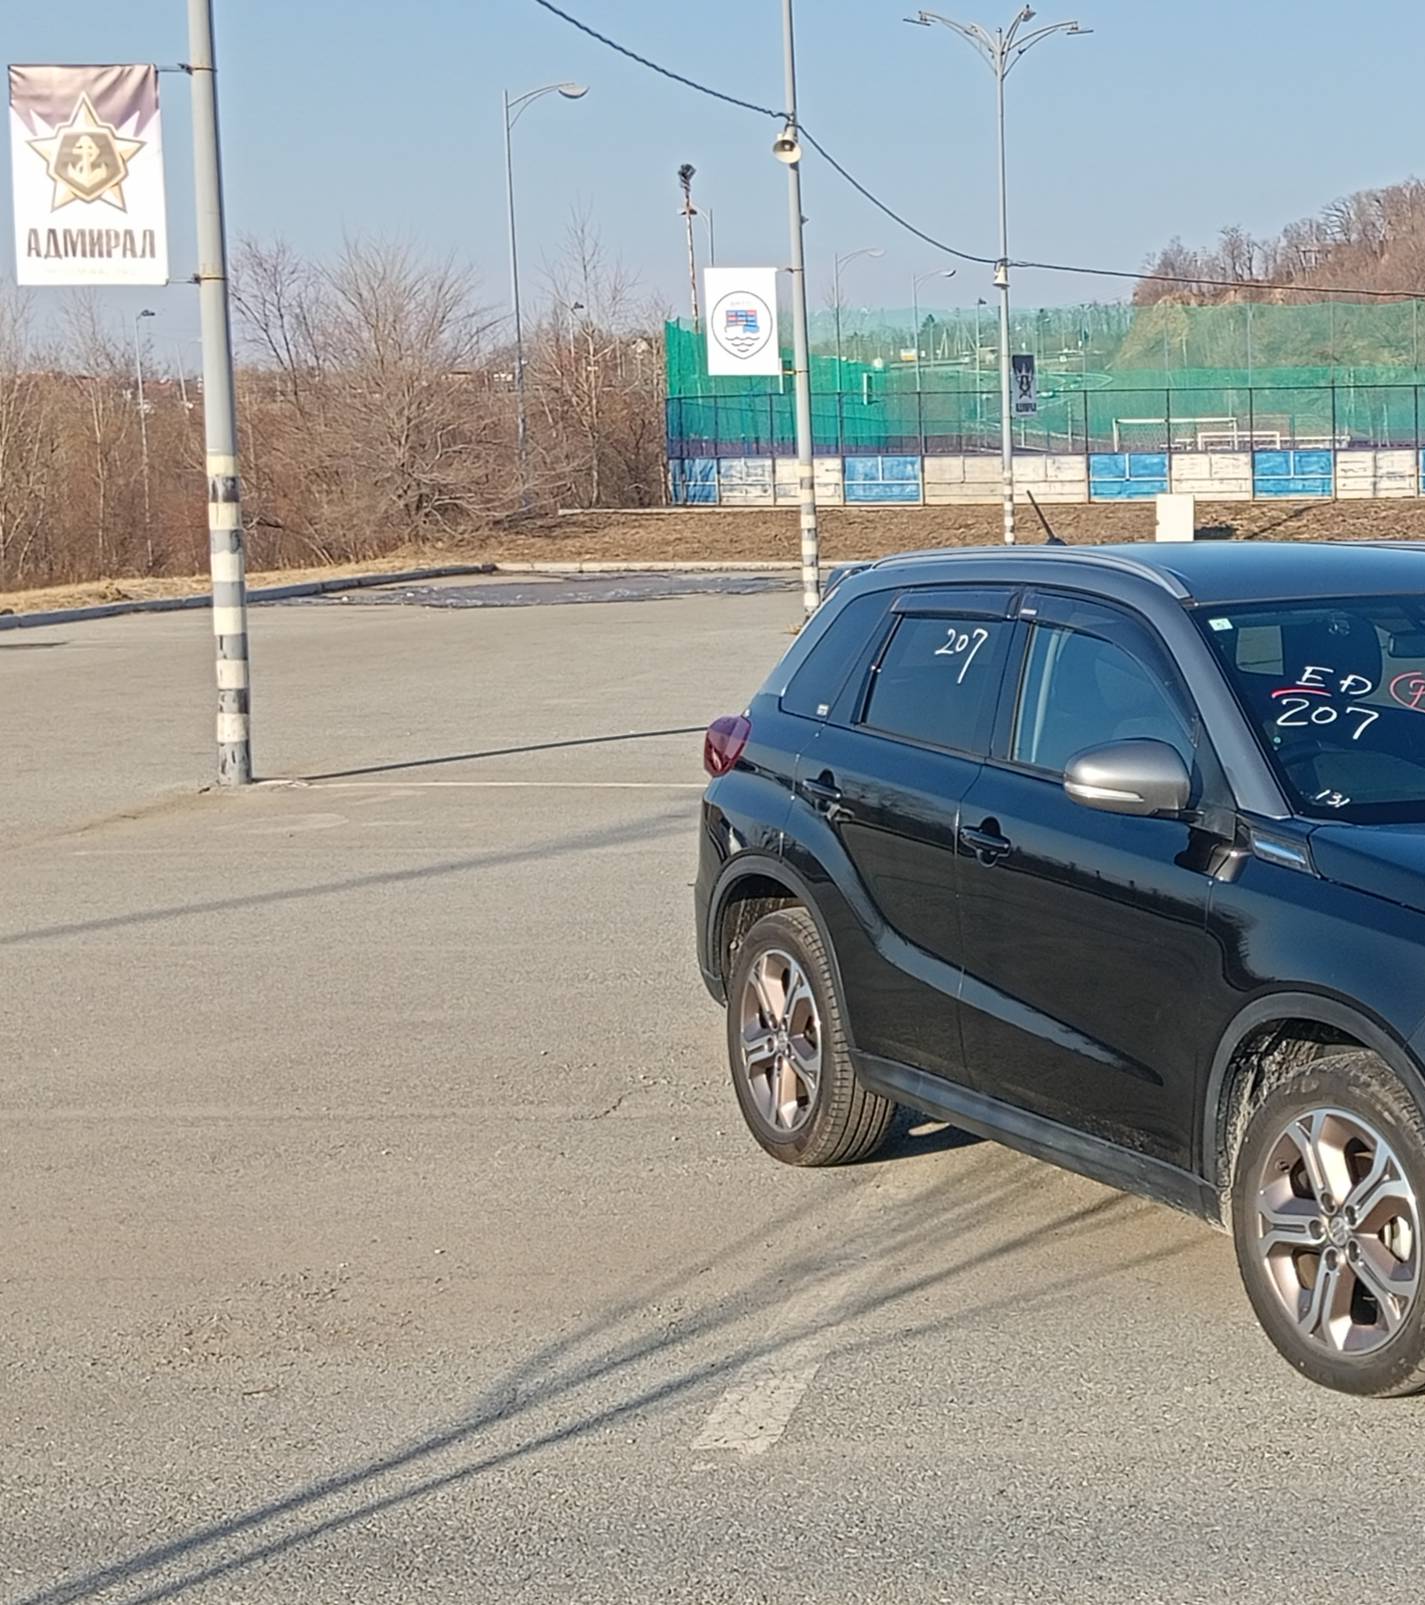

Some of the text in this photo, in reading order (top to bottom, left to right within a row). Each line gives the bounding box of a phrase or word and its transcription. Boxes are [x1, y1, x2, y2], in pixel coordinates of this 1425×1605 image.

[27, 228, 156, 259] АДМИРАЛ
[934, 628, 988, 684] 207
[1276, 698, 1380, 740] 207
